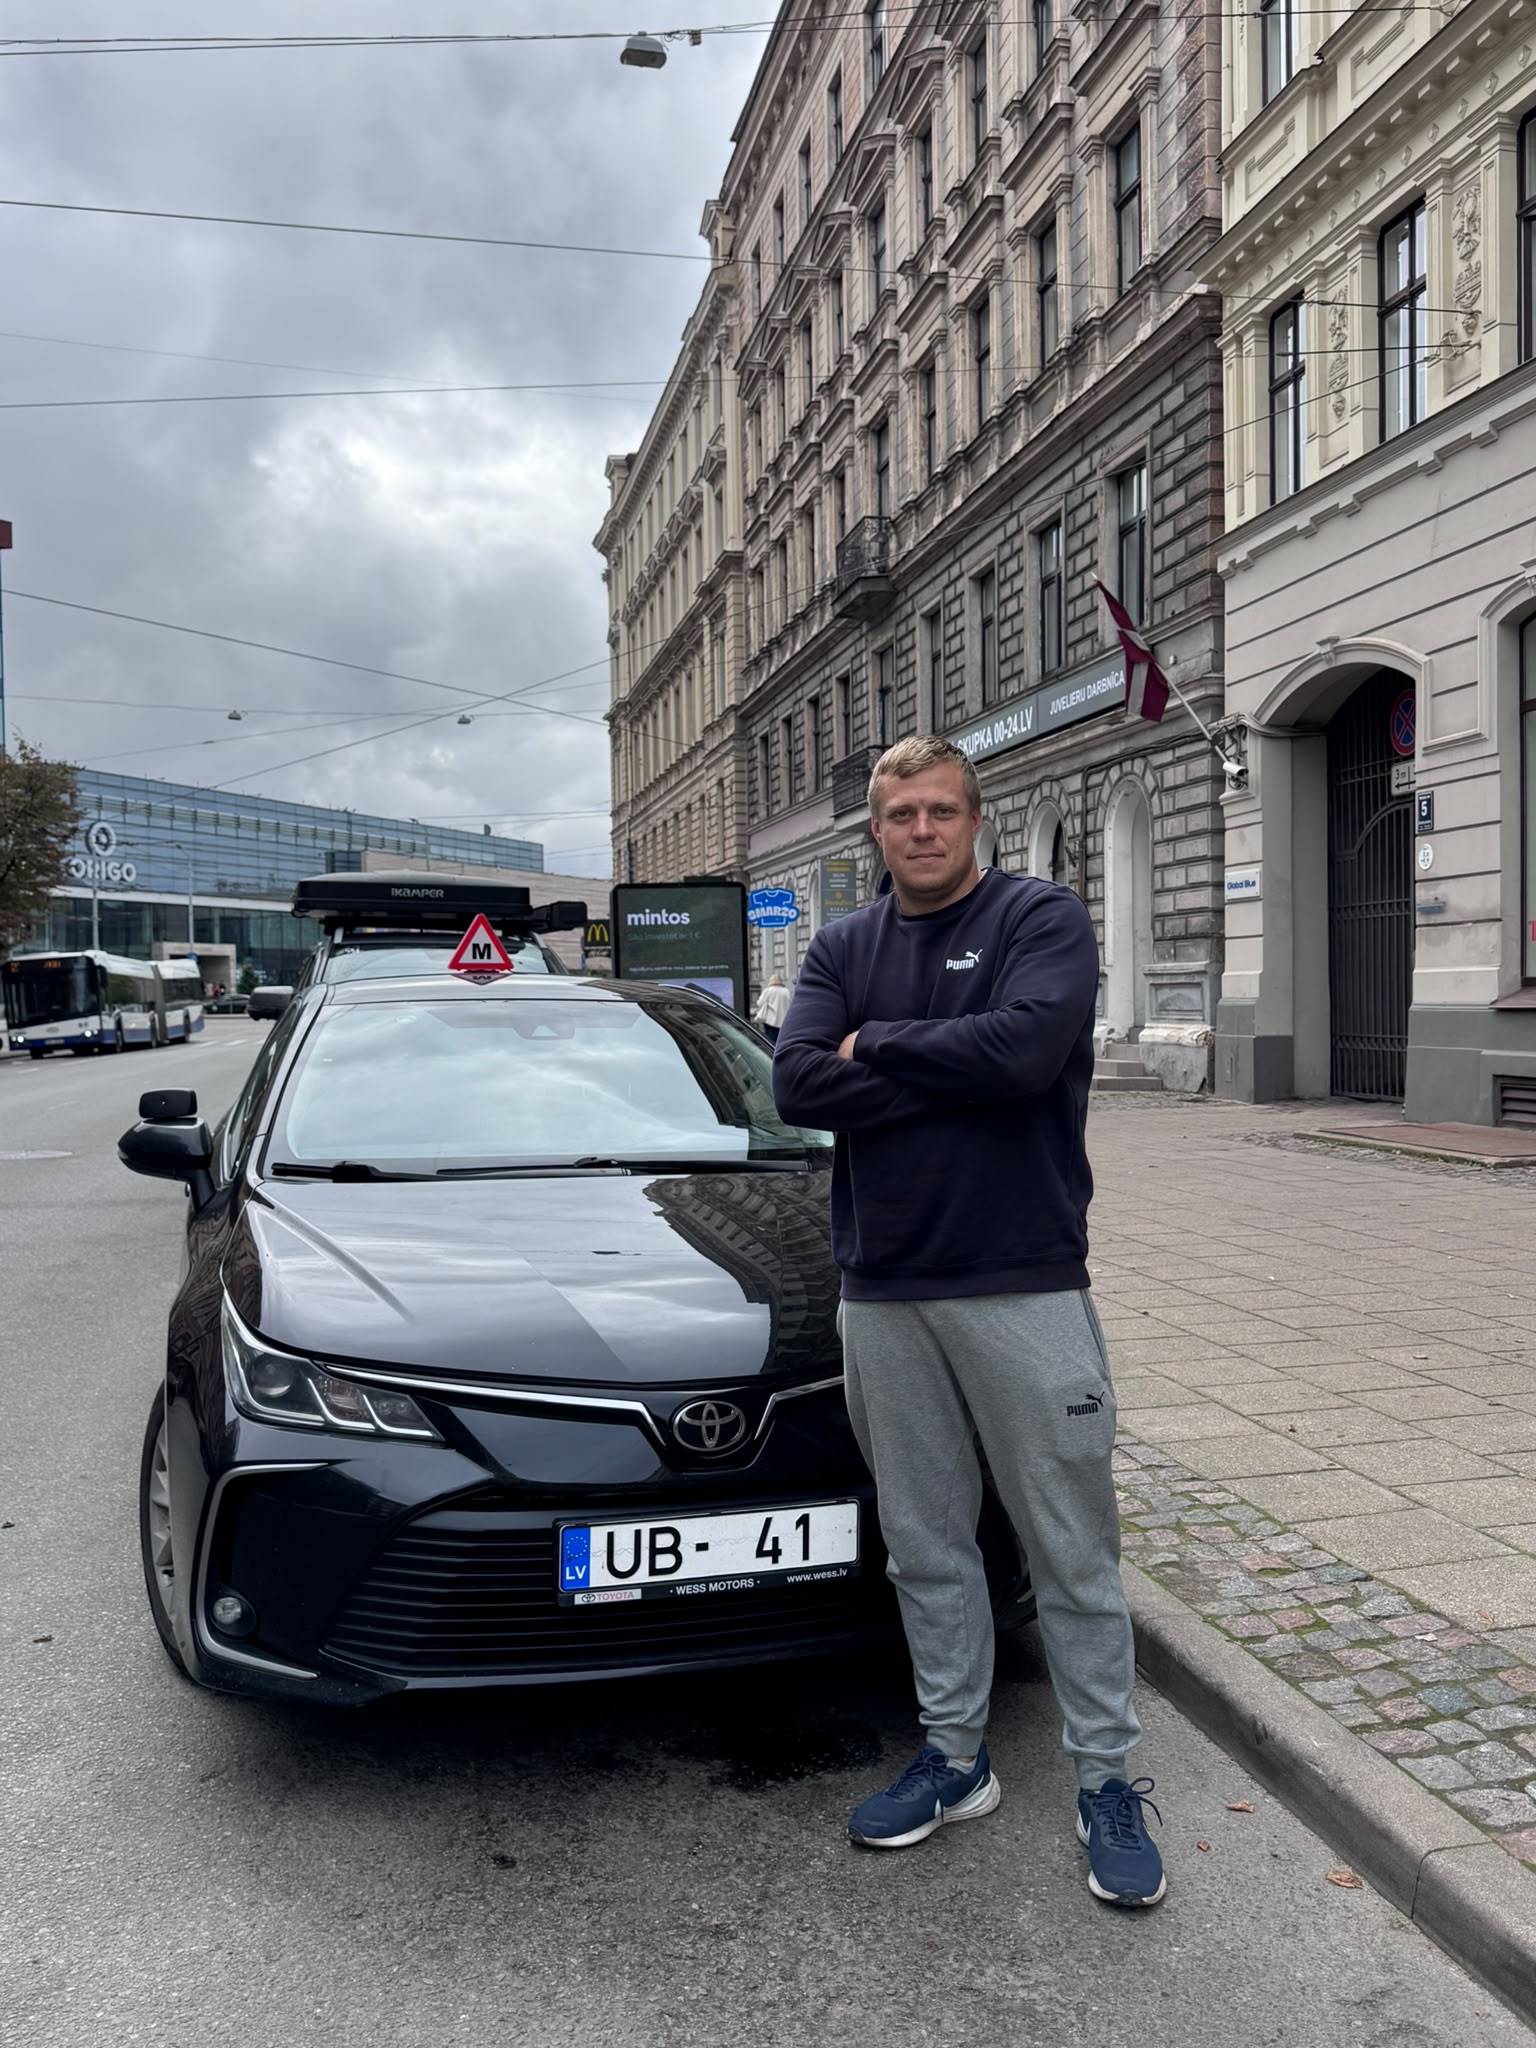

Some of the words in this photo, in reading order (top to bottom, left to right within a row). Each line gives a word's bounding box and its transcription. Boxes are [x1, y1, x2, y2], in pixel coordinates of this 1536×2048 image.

[1049, 687, 1086, 715] JUVELIERU
[1086, 670, 1125, 699] DARBNĪCA
[994, 706, 1033, 745] 00-24.LV
[1420, 800, 1428, 816] 5
[69, 858, 137, 882] ORIGO
[626, 908, 691, 926] mintos
[471, 943, 492, 960] M
[946, 958, 975, 970] PUMA
[1066, 1402, 1099, 1416] PUMA
[755, 1513, 810, 1565] 41
[565, 1565, 587, 1580] LV
[597, 1591, 634, 1601] TOYOTA
[676, 1583, 706, 1595] WESS
[708, 1578, 755, 1593] MOTORS
[787, 1568, 848, 1584] www.wess.lv
